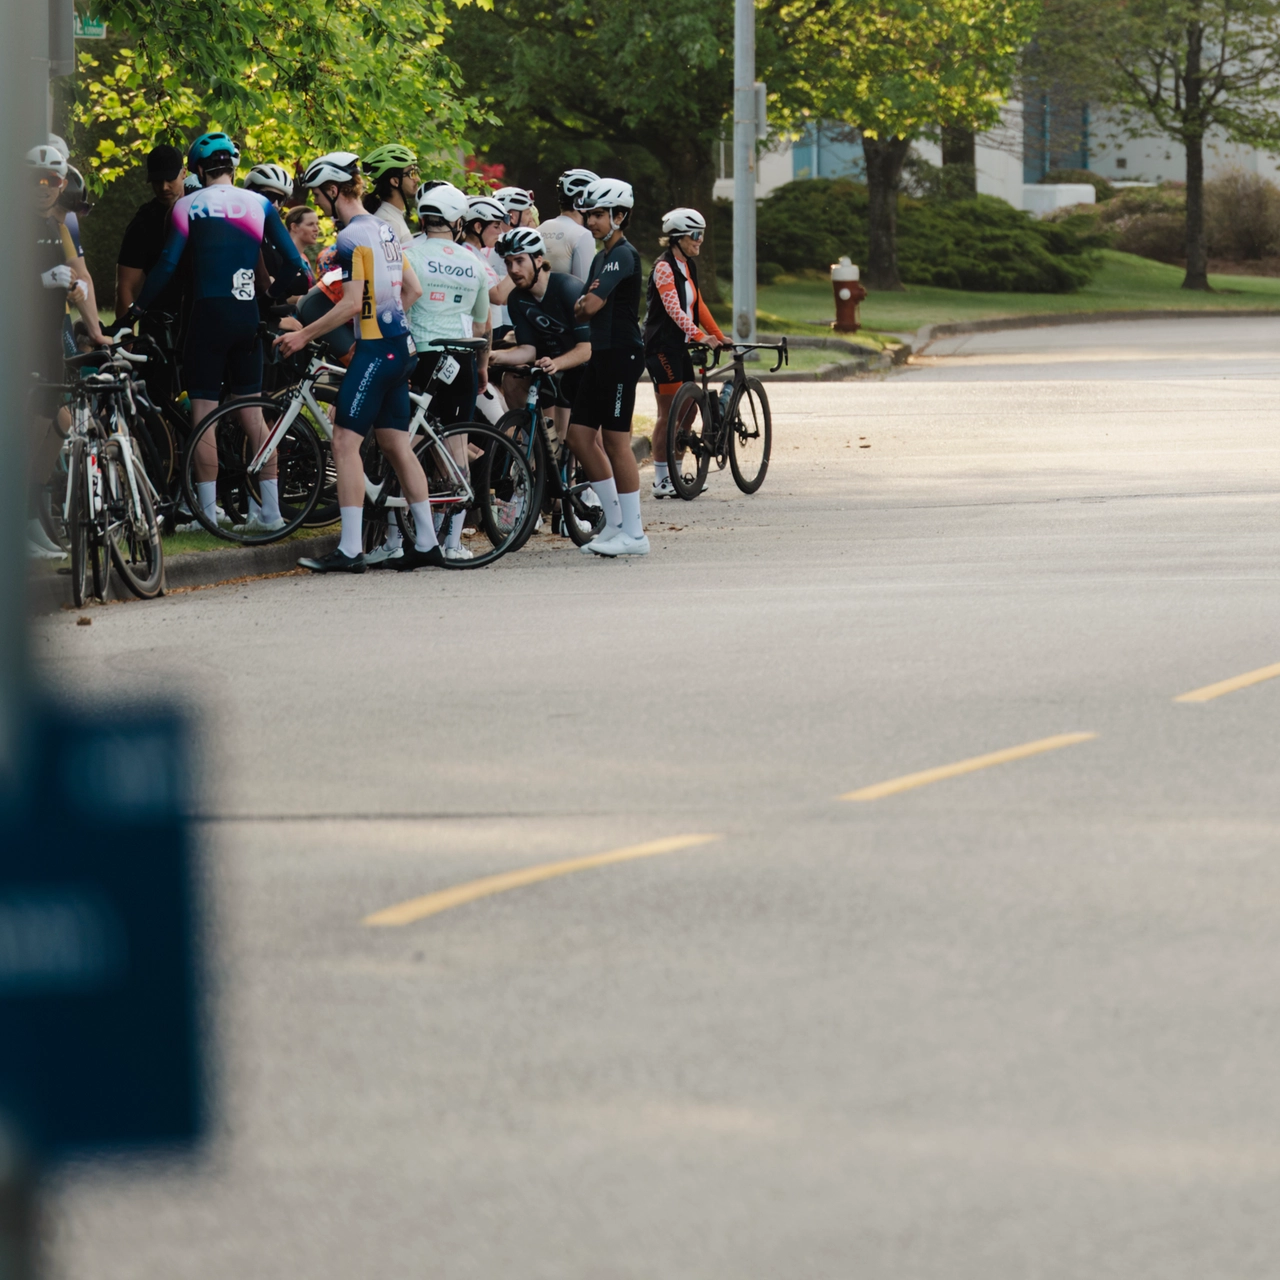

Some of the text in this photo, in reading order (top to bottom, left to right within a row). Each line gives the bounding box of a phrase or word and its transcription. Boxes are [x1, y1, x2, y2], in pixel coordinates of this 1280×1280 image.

[188, 201, 247, 220] RED
[238, 271, 254, 298] 212
[358, 362, 375, 392] COUPAR
